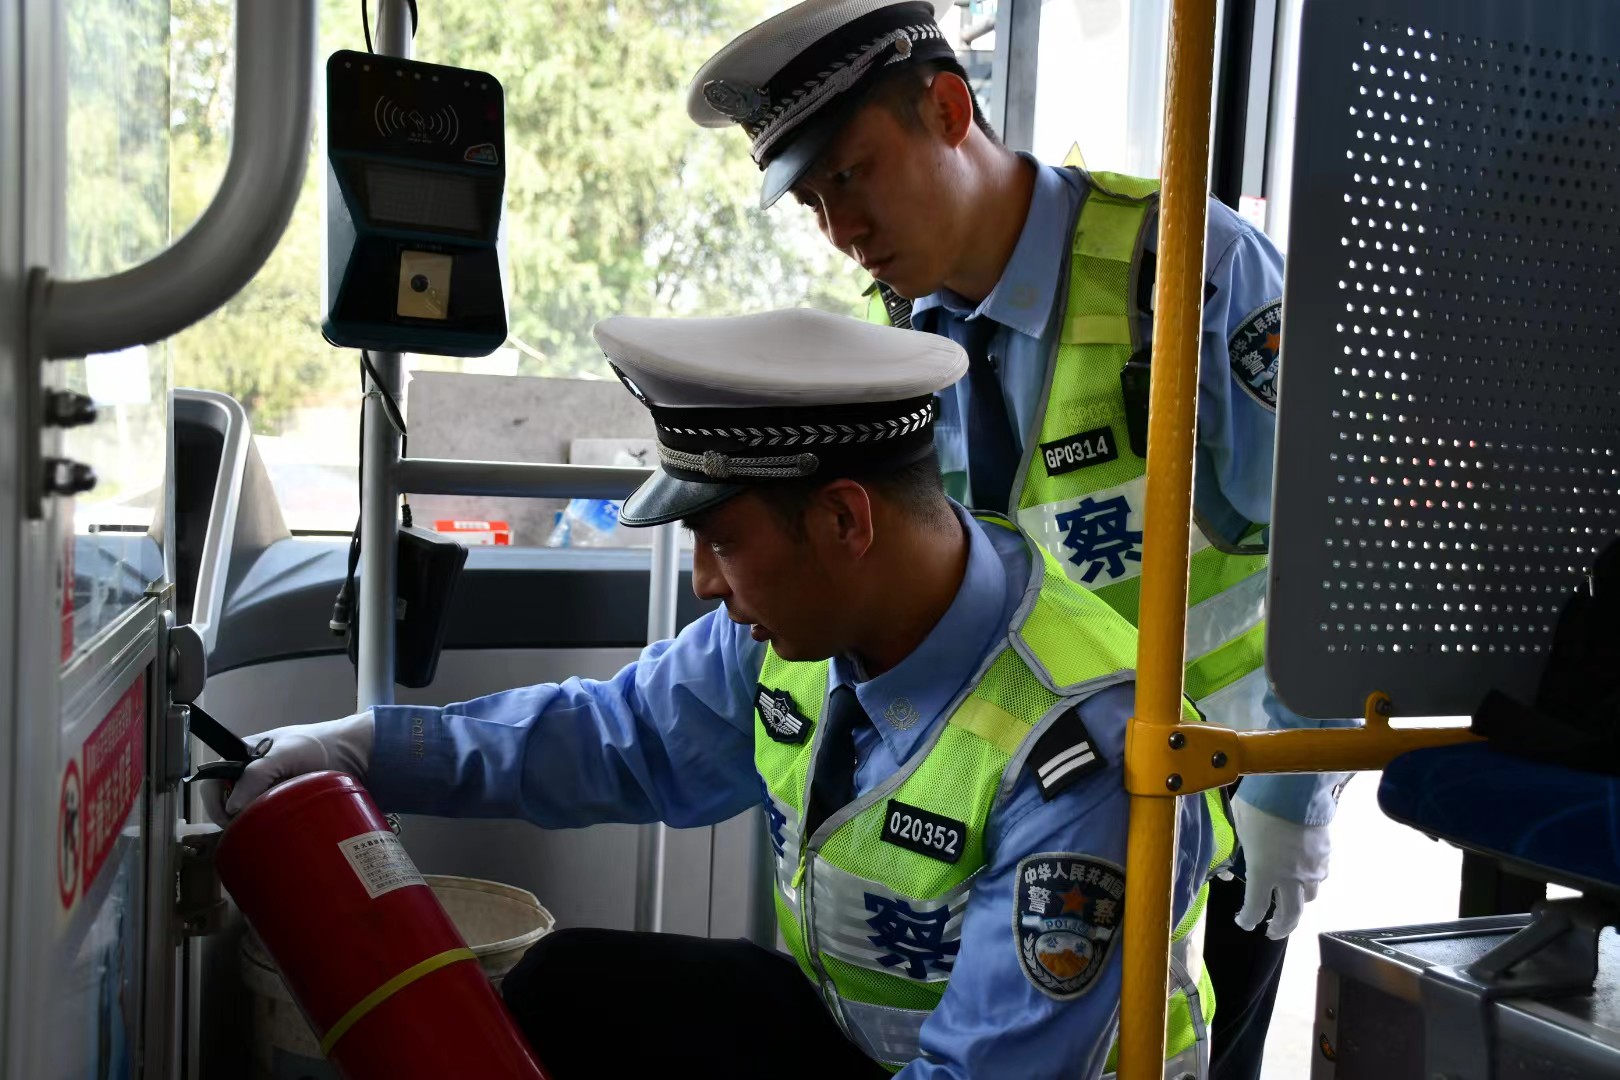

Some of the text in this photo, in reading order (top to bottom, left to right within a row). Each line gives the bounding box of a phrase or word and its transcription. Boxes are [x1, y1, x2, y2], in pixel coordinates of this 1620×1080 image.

[1239, 349, 1266, 377] 警
[1045, 435, 1109, 469] GP0314
[1055, 495, 1143, 583] 察
[889, 811, 959, 855] 020352
[1024, 861, 1125, 900] 中华人民共和国
[863, 891, 961, 979] 察
